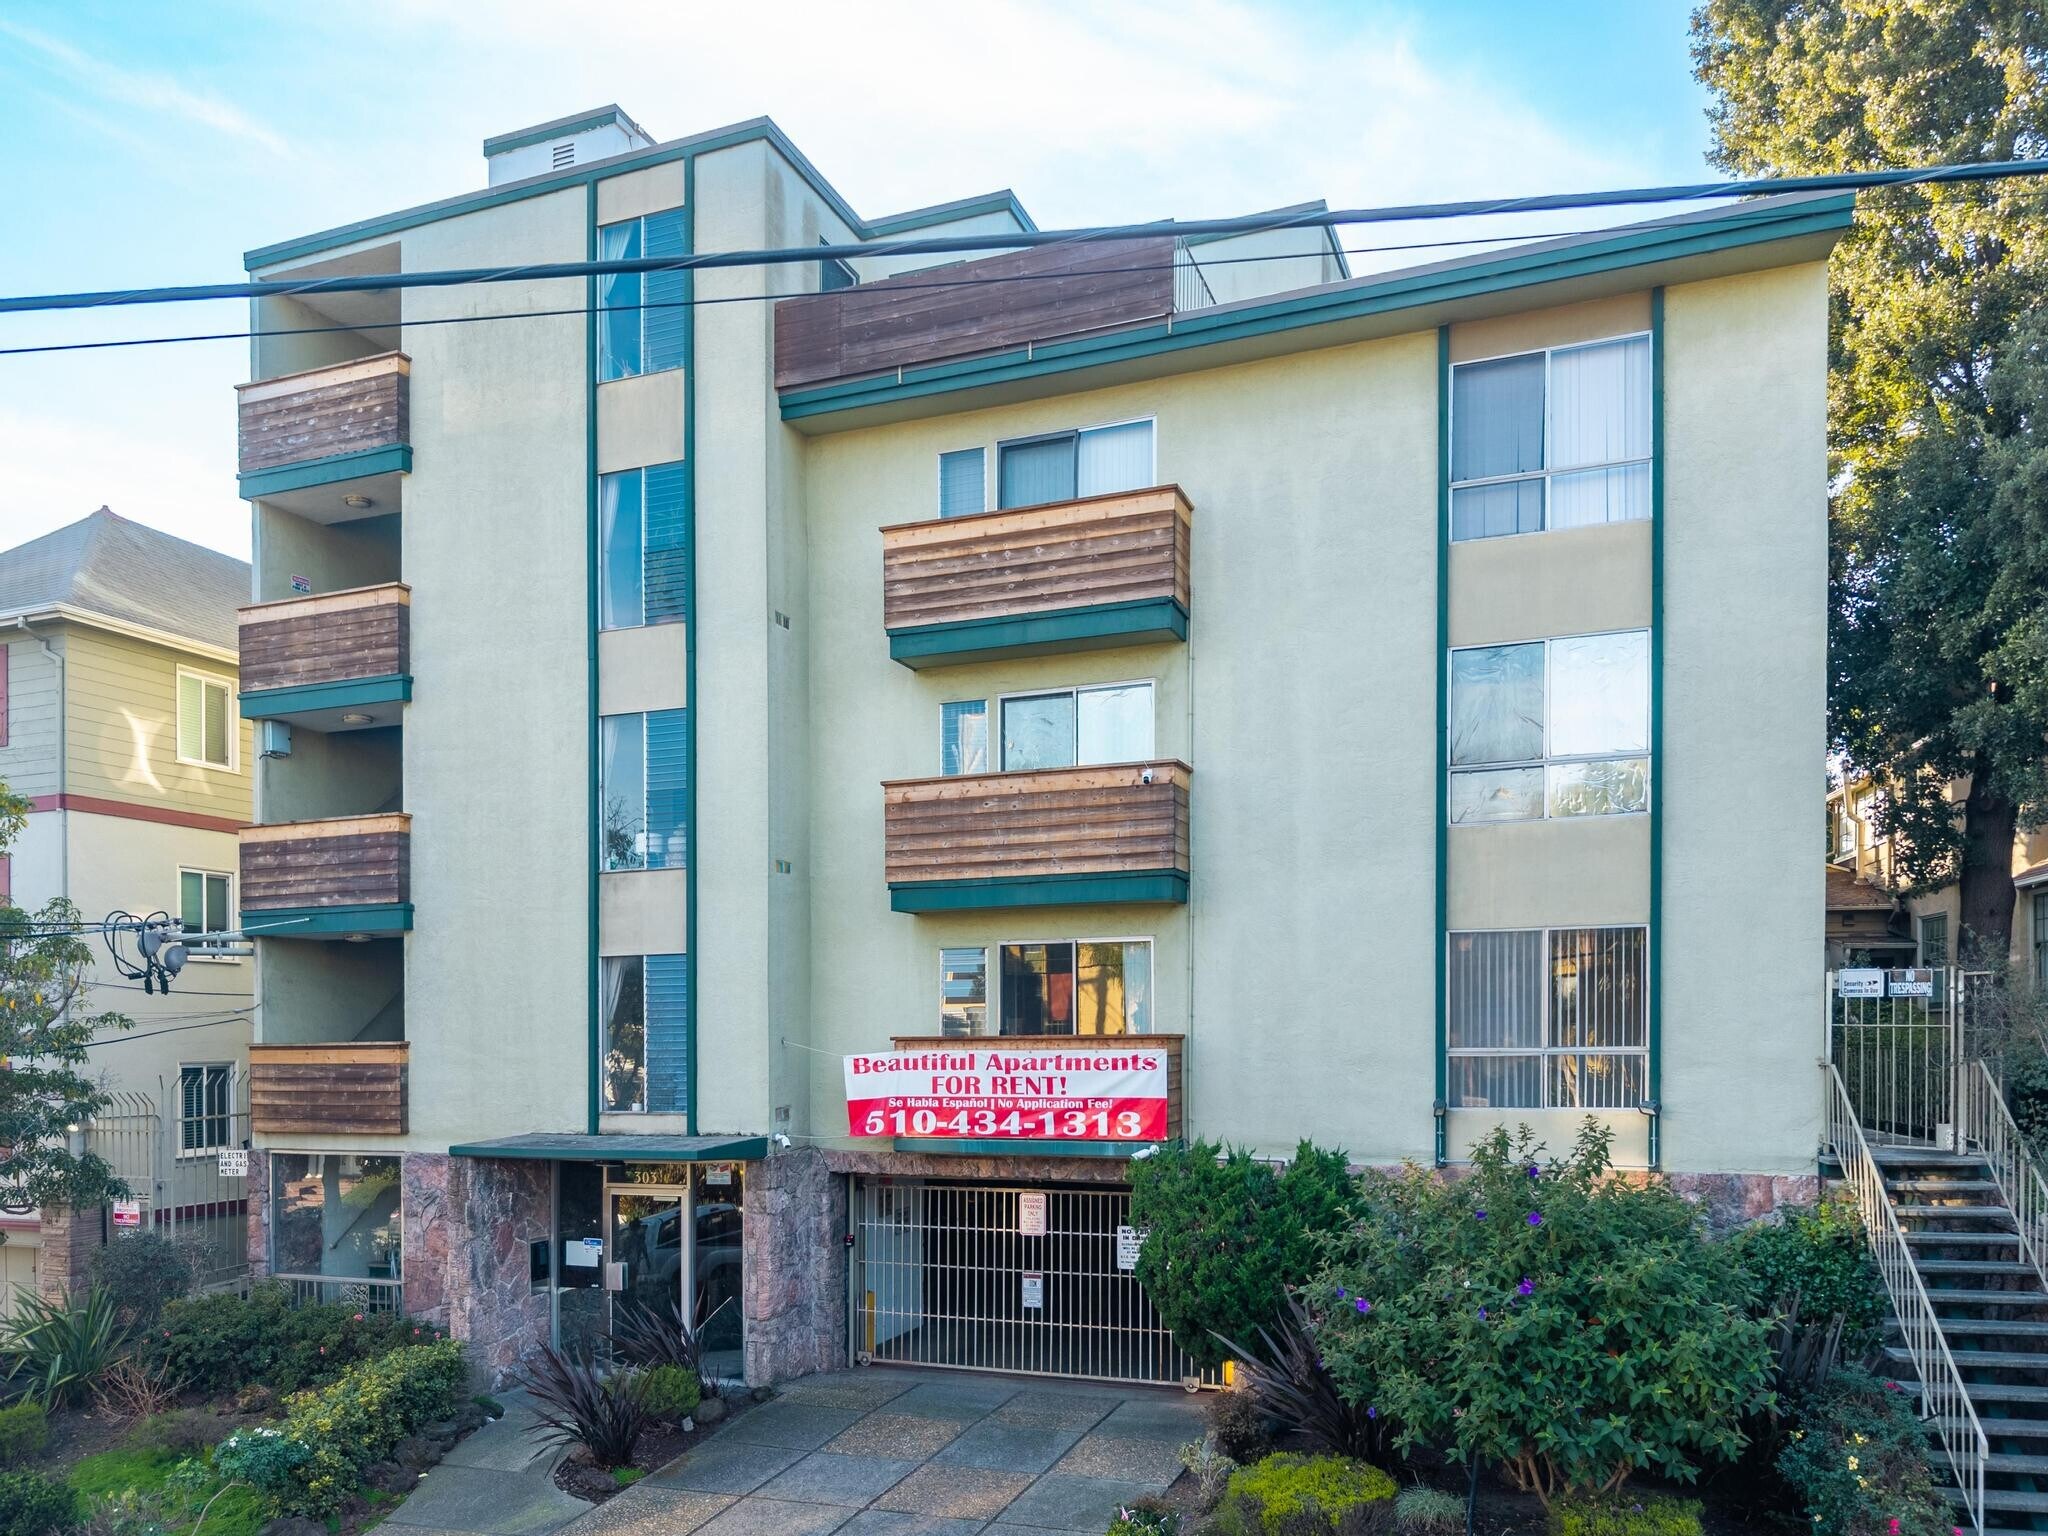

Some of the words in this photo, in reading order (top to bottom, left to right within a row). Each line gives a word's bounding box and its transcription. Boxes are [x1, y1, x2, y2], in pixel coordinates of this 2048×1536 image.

[1906, 970, 1915, 982] NO
[1890, 982, 1932, 995] TRESPASSING
[853, 1053, 975, 1075] Beautiful
[986, 1053, 1158, 1075] Apartments
[931, 1075, 981, 1095] FOR
[991, 1076, 1067, 1096] RENT!
[888, 1097, 904, 1108] Se
[907, 1097, 939, 1108] Habla
[942, 1098, 988, 1110] Español
[997, 1098, 1013, 1109] No
[1017, 1098, 1083, 1110] Application
[1087, 1098, 1113, 1109] Fee!
[865, 1109, 1141, 1137] 510-434-1313
[235, 1160, 247, 1168] GAS
